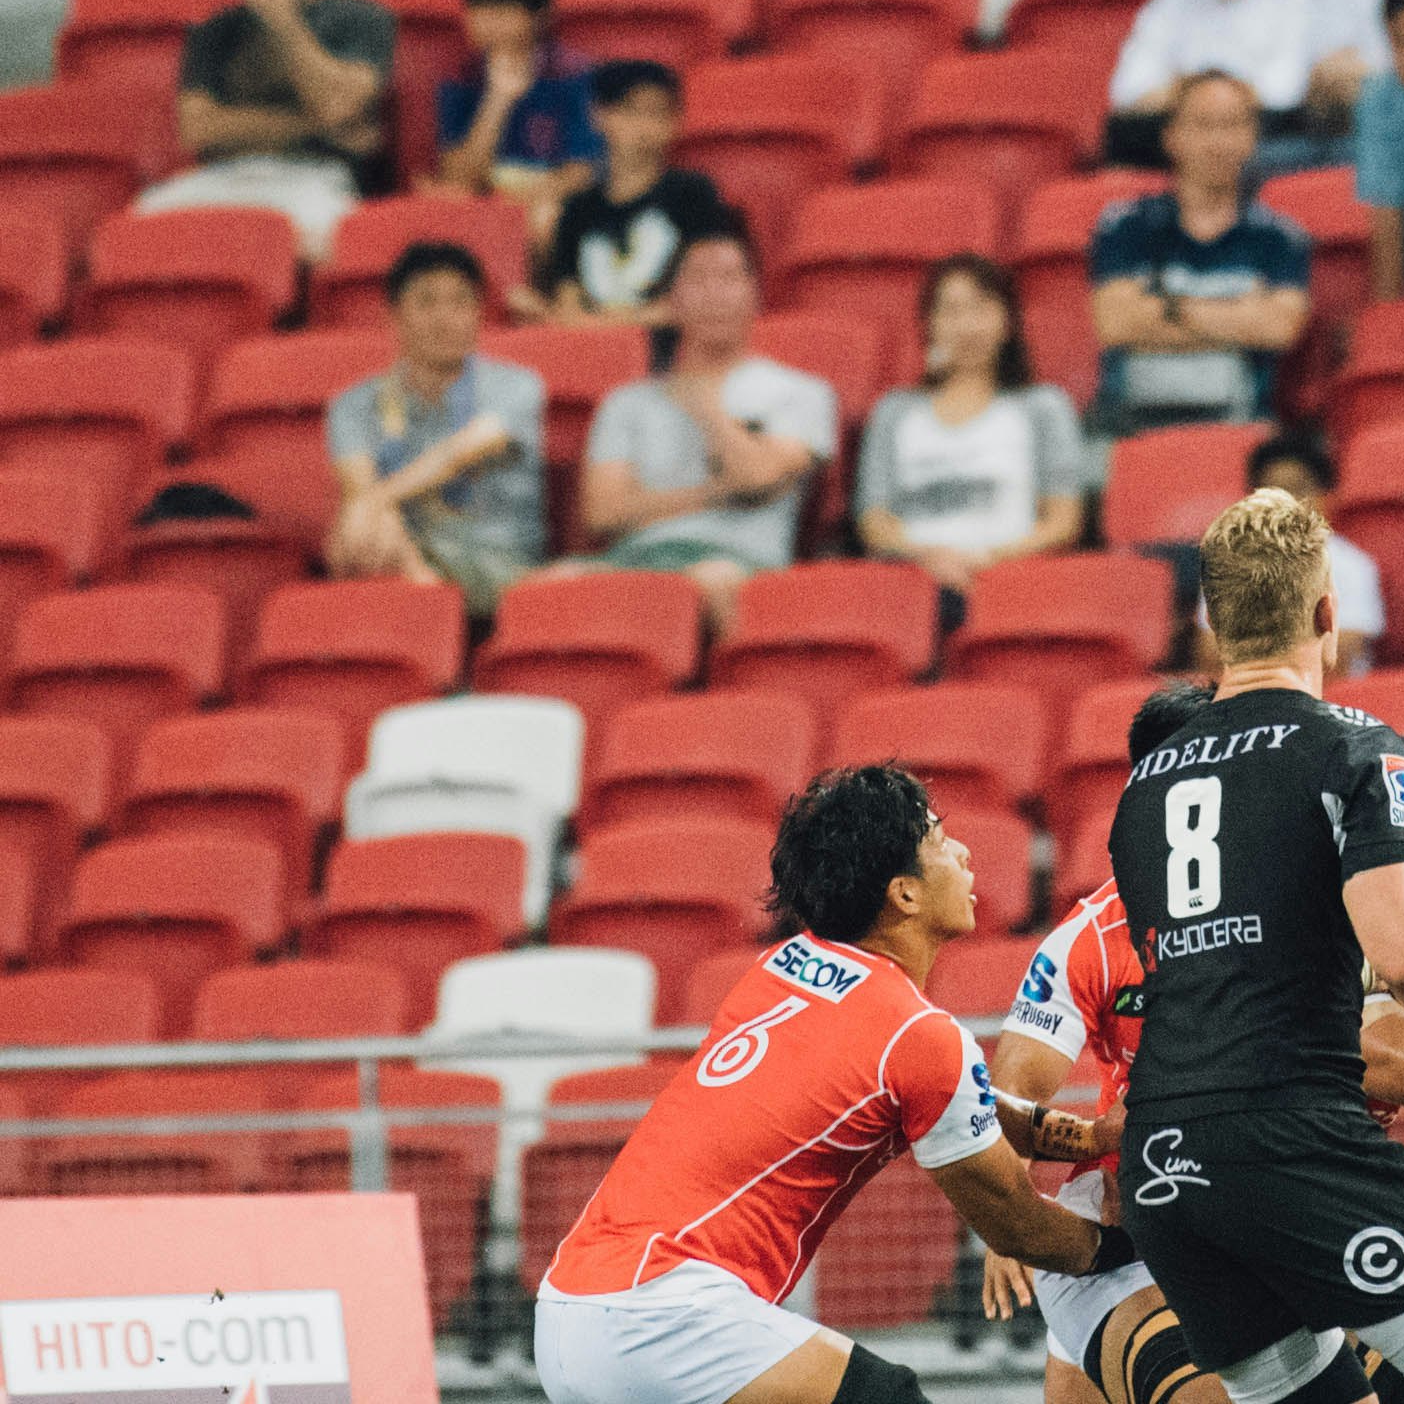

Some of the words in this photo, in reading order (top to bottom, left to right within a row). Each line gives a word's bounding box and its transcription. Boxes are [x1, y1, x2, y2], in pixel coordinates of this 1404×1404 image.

[1165, 776, 1222, 918] 8
[773, 942, 861, 994] SECOM
[1158, 914, 1263, 962] KYOCERA
[696, 995, 810, 1088] 6
[1135, 1128, 1211, 1206] Sun
[32, 1314, 316, 1372] HITO-com
